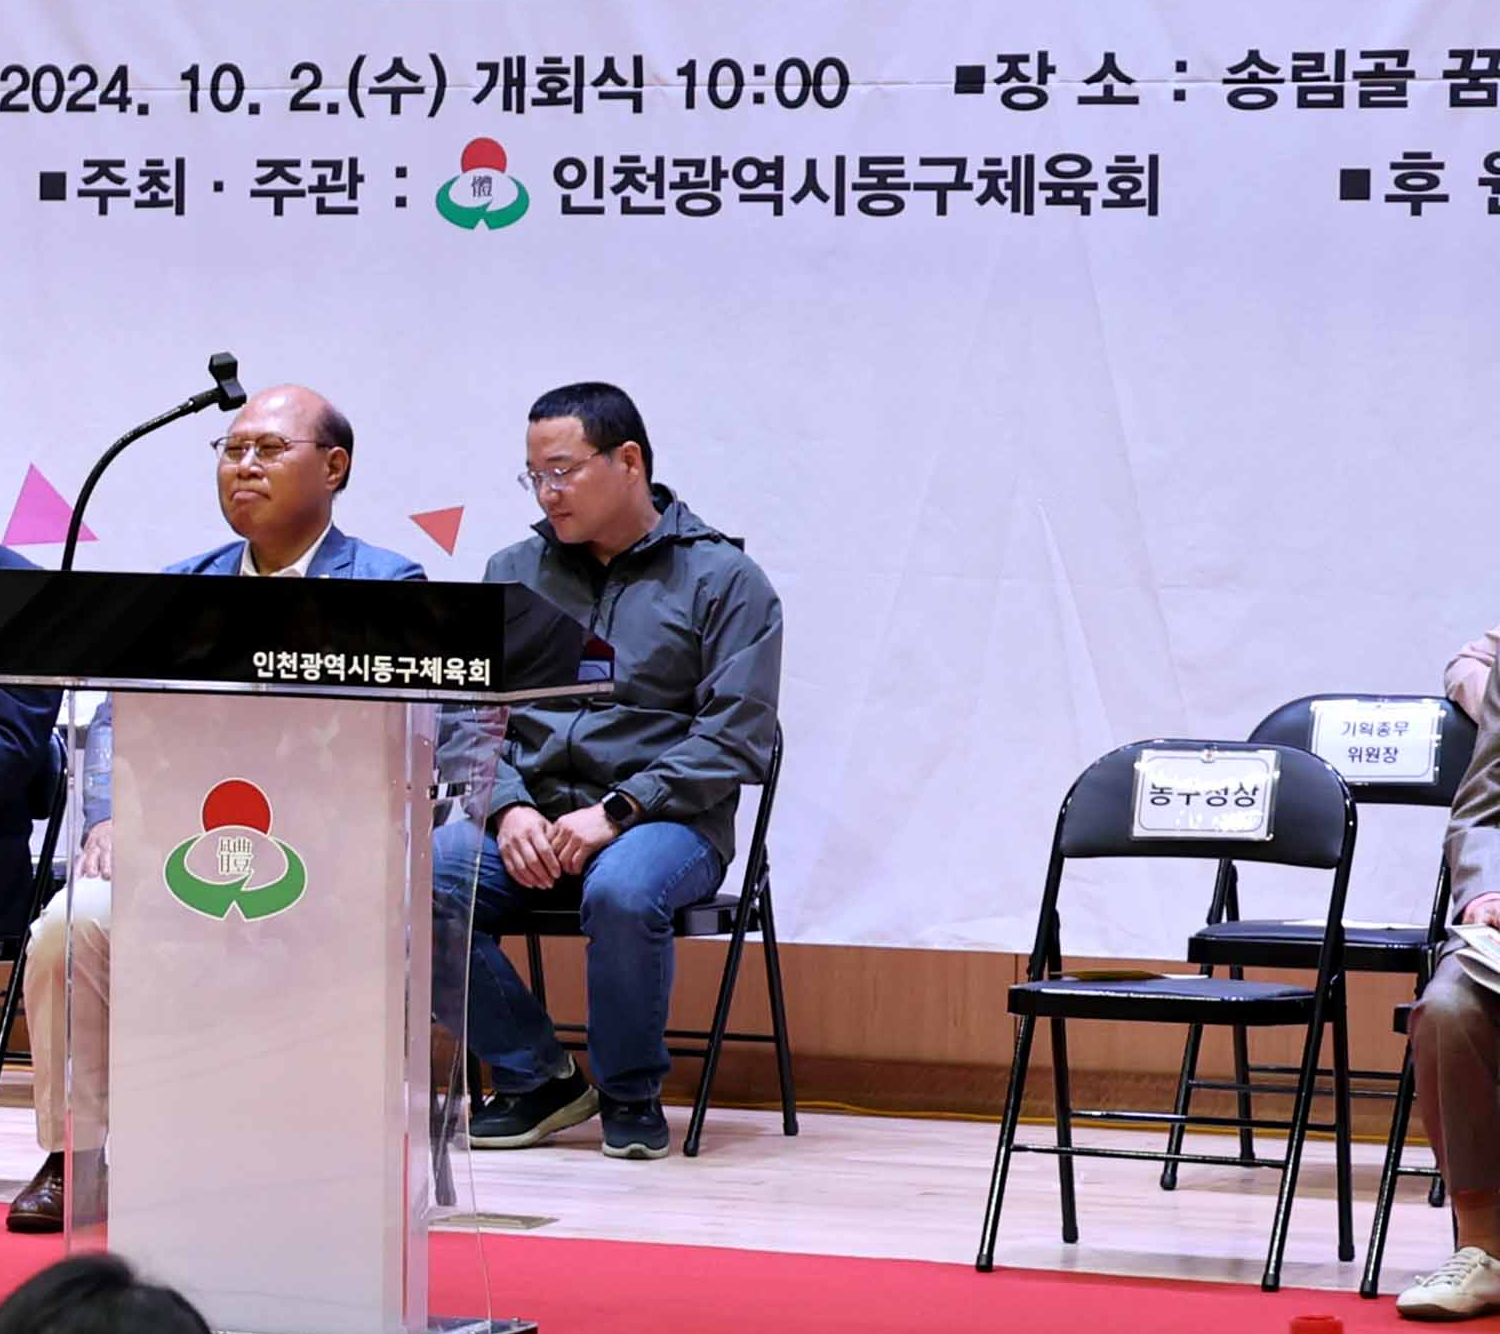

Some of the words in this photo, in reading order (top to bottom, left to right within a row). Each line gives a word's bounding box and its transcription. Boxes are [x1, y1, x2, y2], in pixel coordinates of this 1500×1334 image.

[180, 62, 261, 116] 10.
[289, 52, 447, 119] 2.(수)
[472, 53, 644, 115] 개회식
[676, 56, 850, 111] 10:00
[1222, 48, 1416, 111] 송림골
[76, 157, 186, 216] 주최
[250, 157, 365, 216] 주관
[553, 154, 1160, 217] 인천광역시동구체육회
[252, 649, 492, 687] 인천광역시동구체육회
[1347, 746, 1399, 764] 위원장
